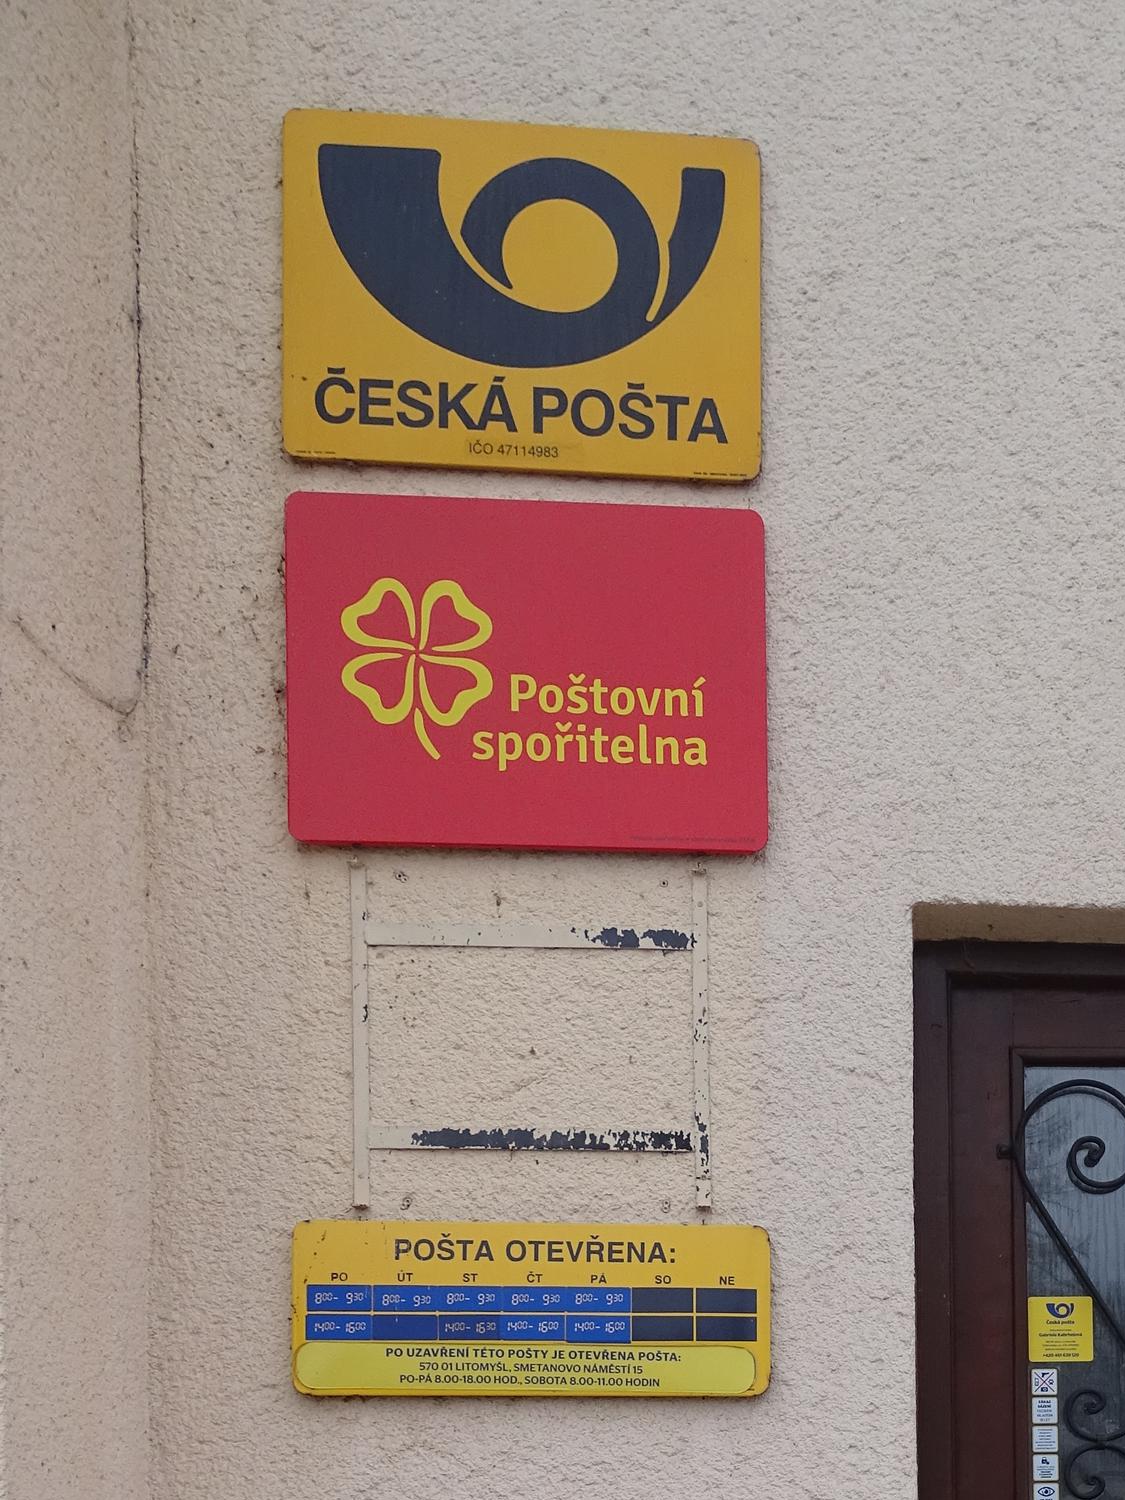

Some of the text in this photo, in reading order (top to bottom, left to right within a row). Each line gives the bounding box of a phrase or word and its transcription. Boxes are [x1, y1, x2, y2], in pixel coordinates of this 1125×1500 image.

[314, 366, 729, 445] ČESKÁ POŠTA
[468, 441, 560, 459] IČO 47114983
[509, 672, 707, 718] Poštovní
[471, 720, 709, 772] spořitelna
[394, 1232, 677, 1264] POŠTA OTEVŘENA:
[330, 1269, 736, 1286] PO ÚT ST ČT PÁ SO NE
[385, 1346, 682, 1362] PO UZAVŘENÍ TÉTO POŠTY JE OTEVŘENA POŠTA:
[419, 1361, 643, 1374] 570 01 LITOMYŠL, SMETANOVO NÁMĚSTÍ 15
[399, 1373, 433, 1384] PO-PÁ
[434, 1374, 492, 1384] 8.00-18.00
[524, 1376, 567, 1386] SOBOTA
[569, 1376, 623, 1387] 8.00-11.00
[625, 1378, 661, 1387] HODIN
